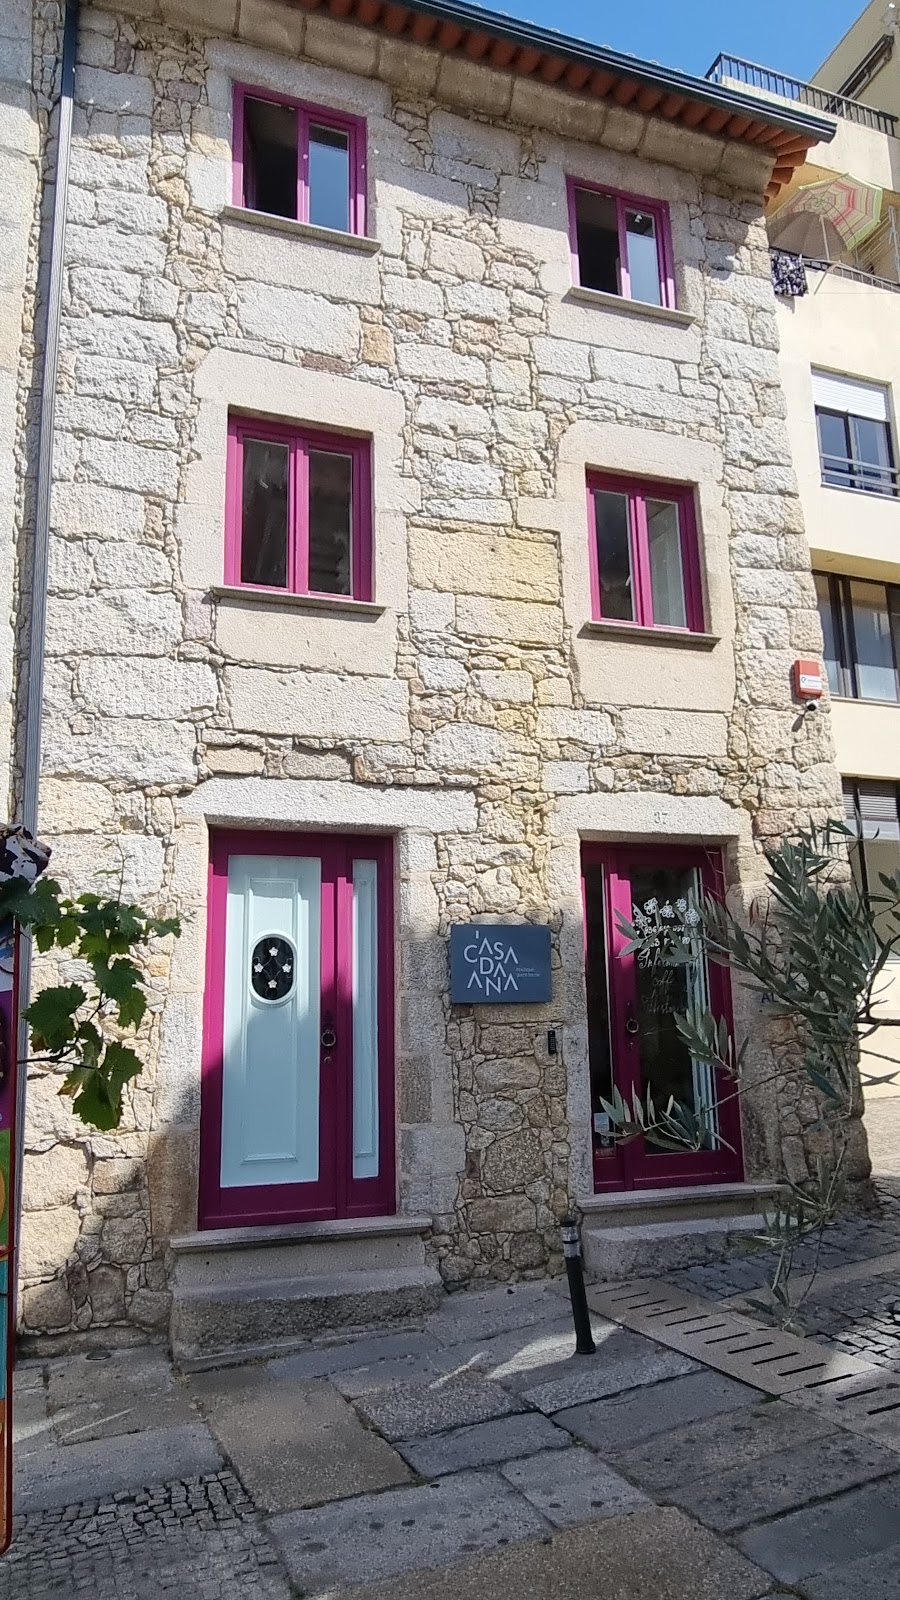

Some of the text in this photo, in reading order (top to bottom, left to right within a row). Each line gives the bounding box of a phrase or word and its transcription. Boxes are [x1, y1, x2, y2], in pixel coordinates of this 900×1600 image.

[463, 937, 519, 965] CASA
[479, 956, 508, 978] DA
[466, 970, 519, 997] ANA
